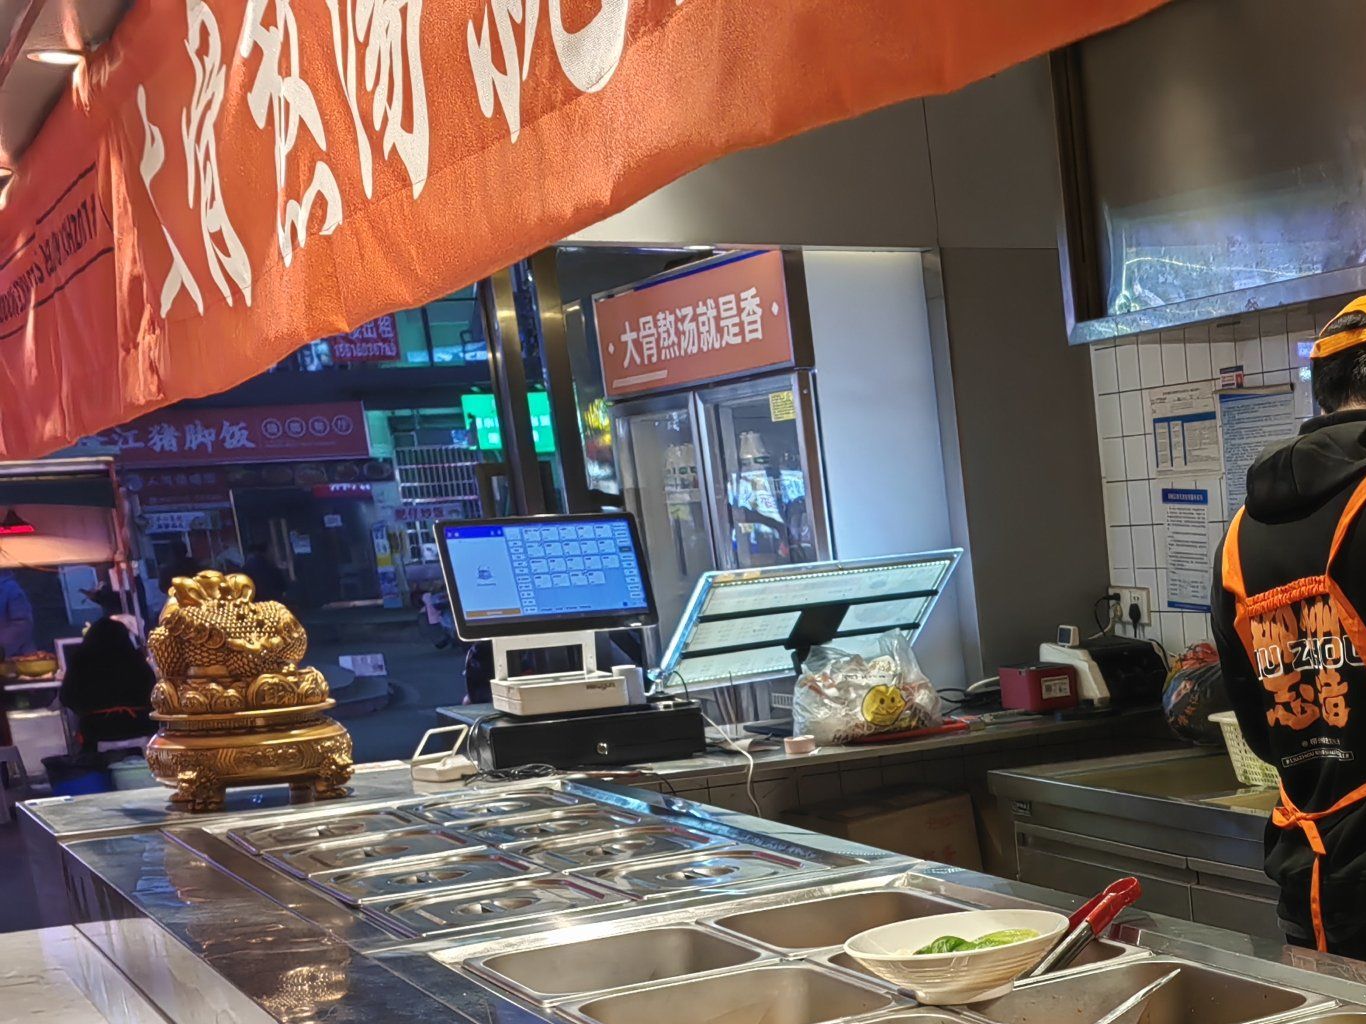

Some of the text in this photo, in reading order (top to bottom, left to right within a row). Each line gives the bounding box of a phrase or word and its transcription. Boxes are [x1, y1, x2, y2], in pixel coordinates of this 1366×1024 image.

[620, 287, 763, 369] 大骨熬汤就是香
